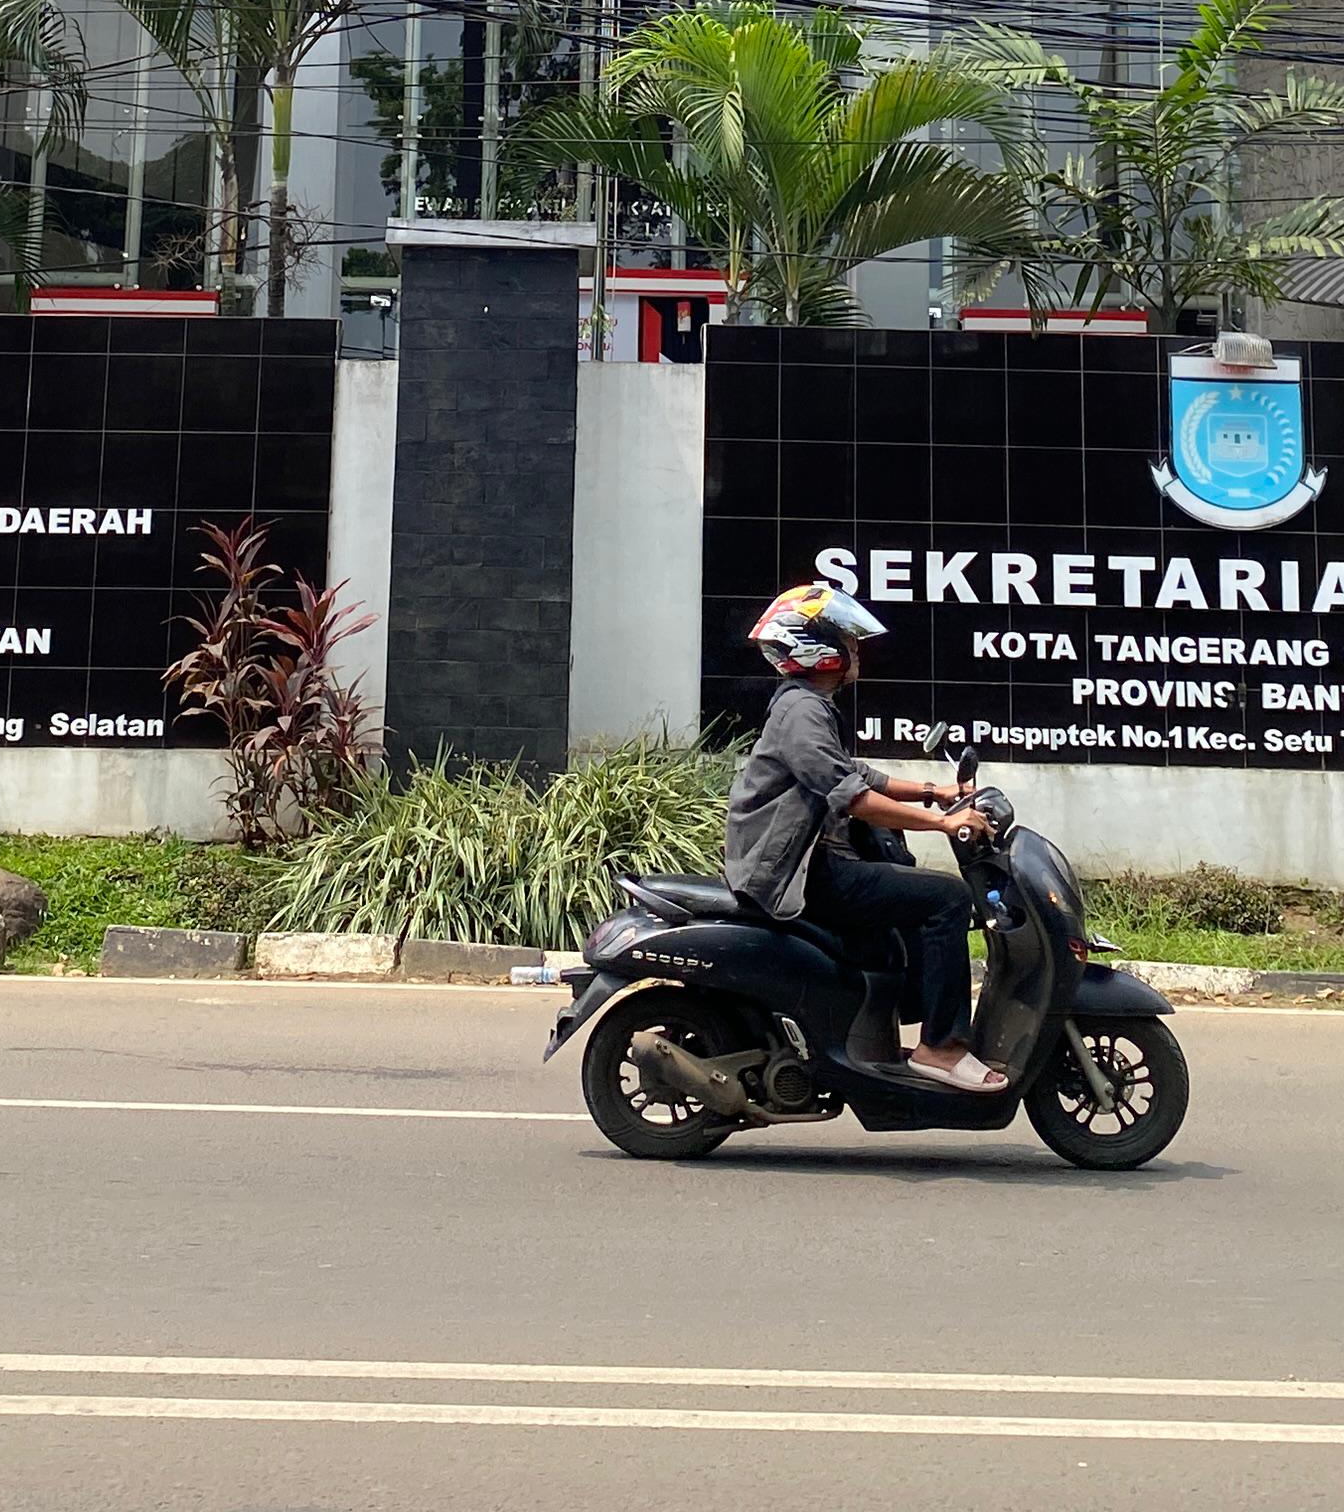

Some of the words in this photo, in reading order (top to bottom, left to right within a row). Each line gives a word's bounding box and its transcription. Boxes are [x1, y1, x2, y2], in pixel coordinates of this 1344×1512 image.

[974, 632, 1077, 660] KOTA
[1095, 635, 1329, 666] TANGERANG
[50, 713, 163, 736] Selatan
[894, 718, 965, 744] Raa
[1264, 729, 1332, 752] Setu
[632, 950, 714, 969] SCOOPY
